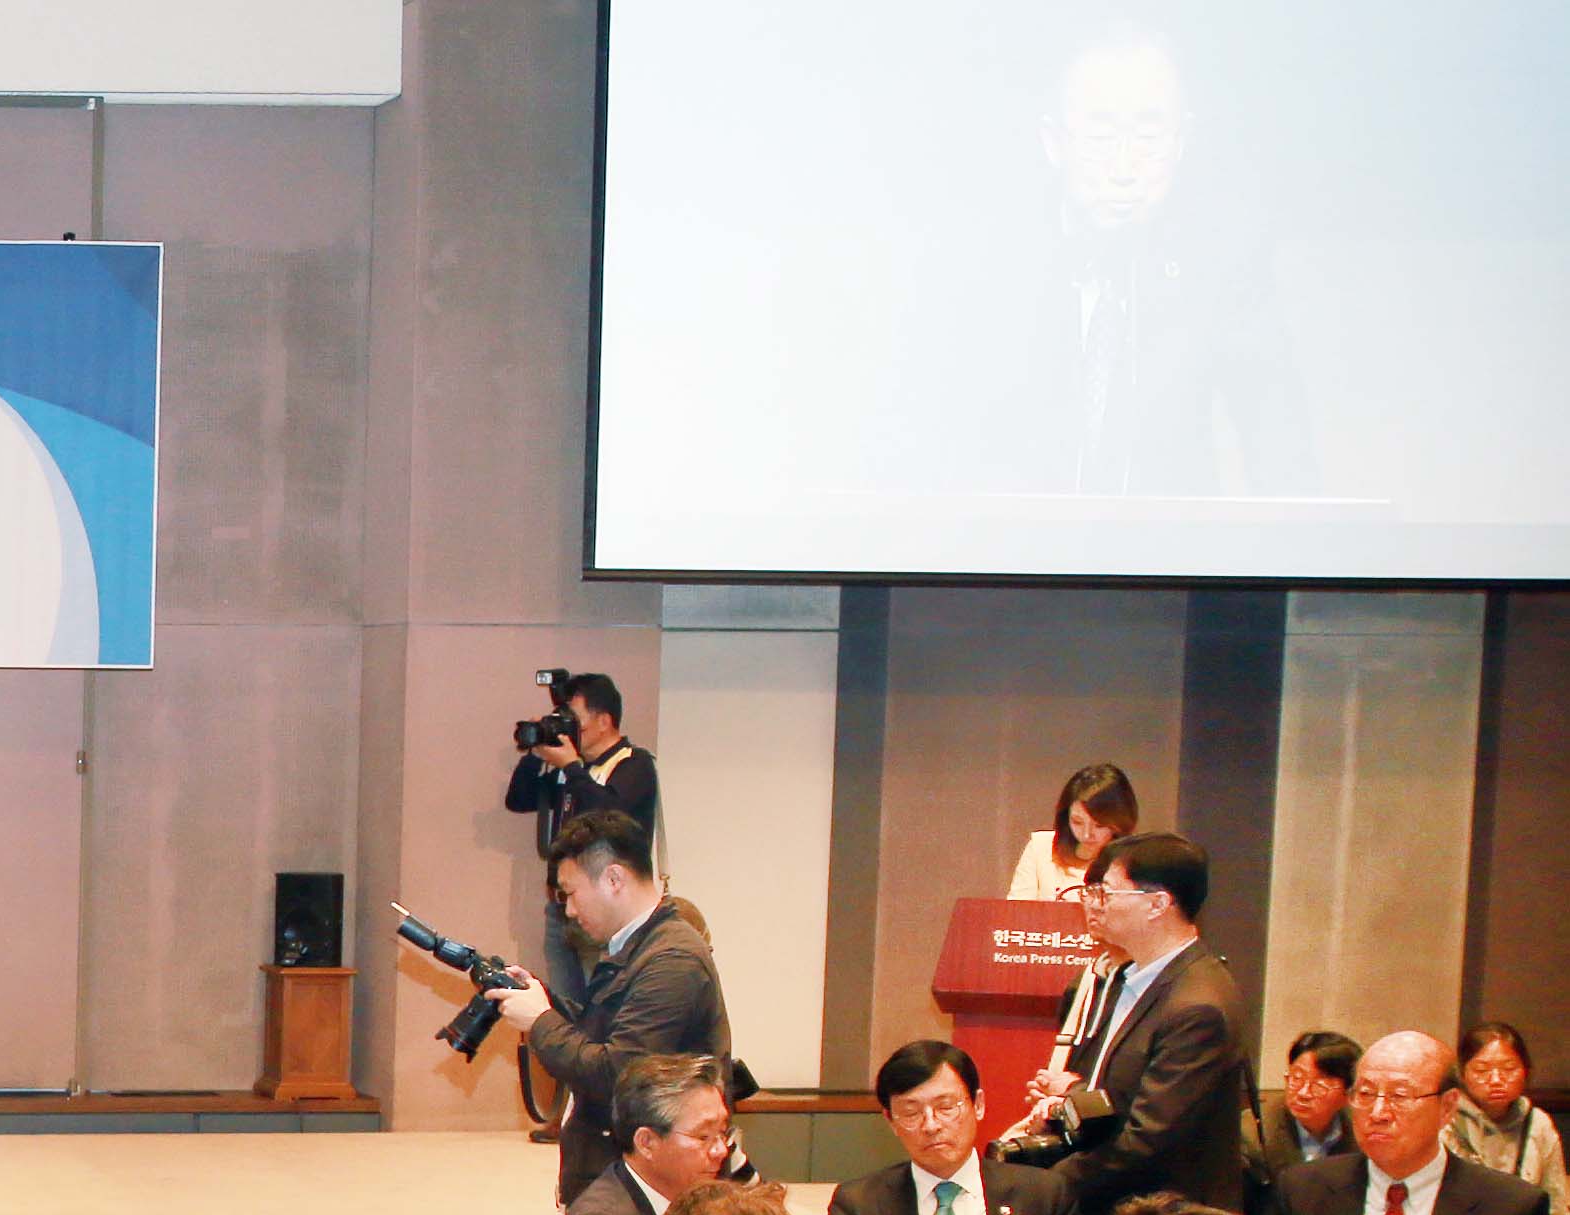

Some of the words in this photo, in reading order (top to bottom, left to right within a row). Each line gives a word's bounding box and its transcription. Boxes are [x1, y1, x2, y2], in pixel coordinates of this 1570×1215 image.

[993, 929, 1098, 950] 한국프레스센
[993, 951, 1028, 964] Korea
[1029, 952, 1063, 966] Press
